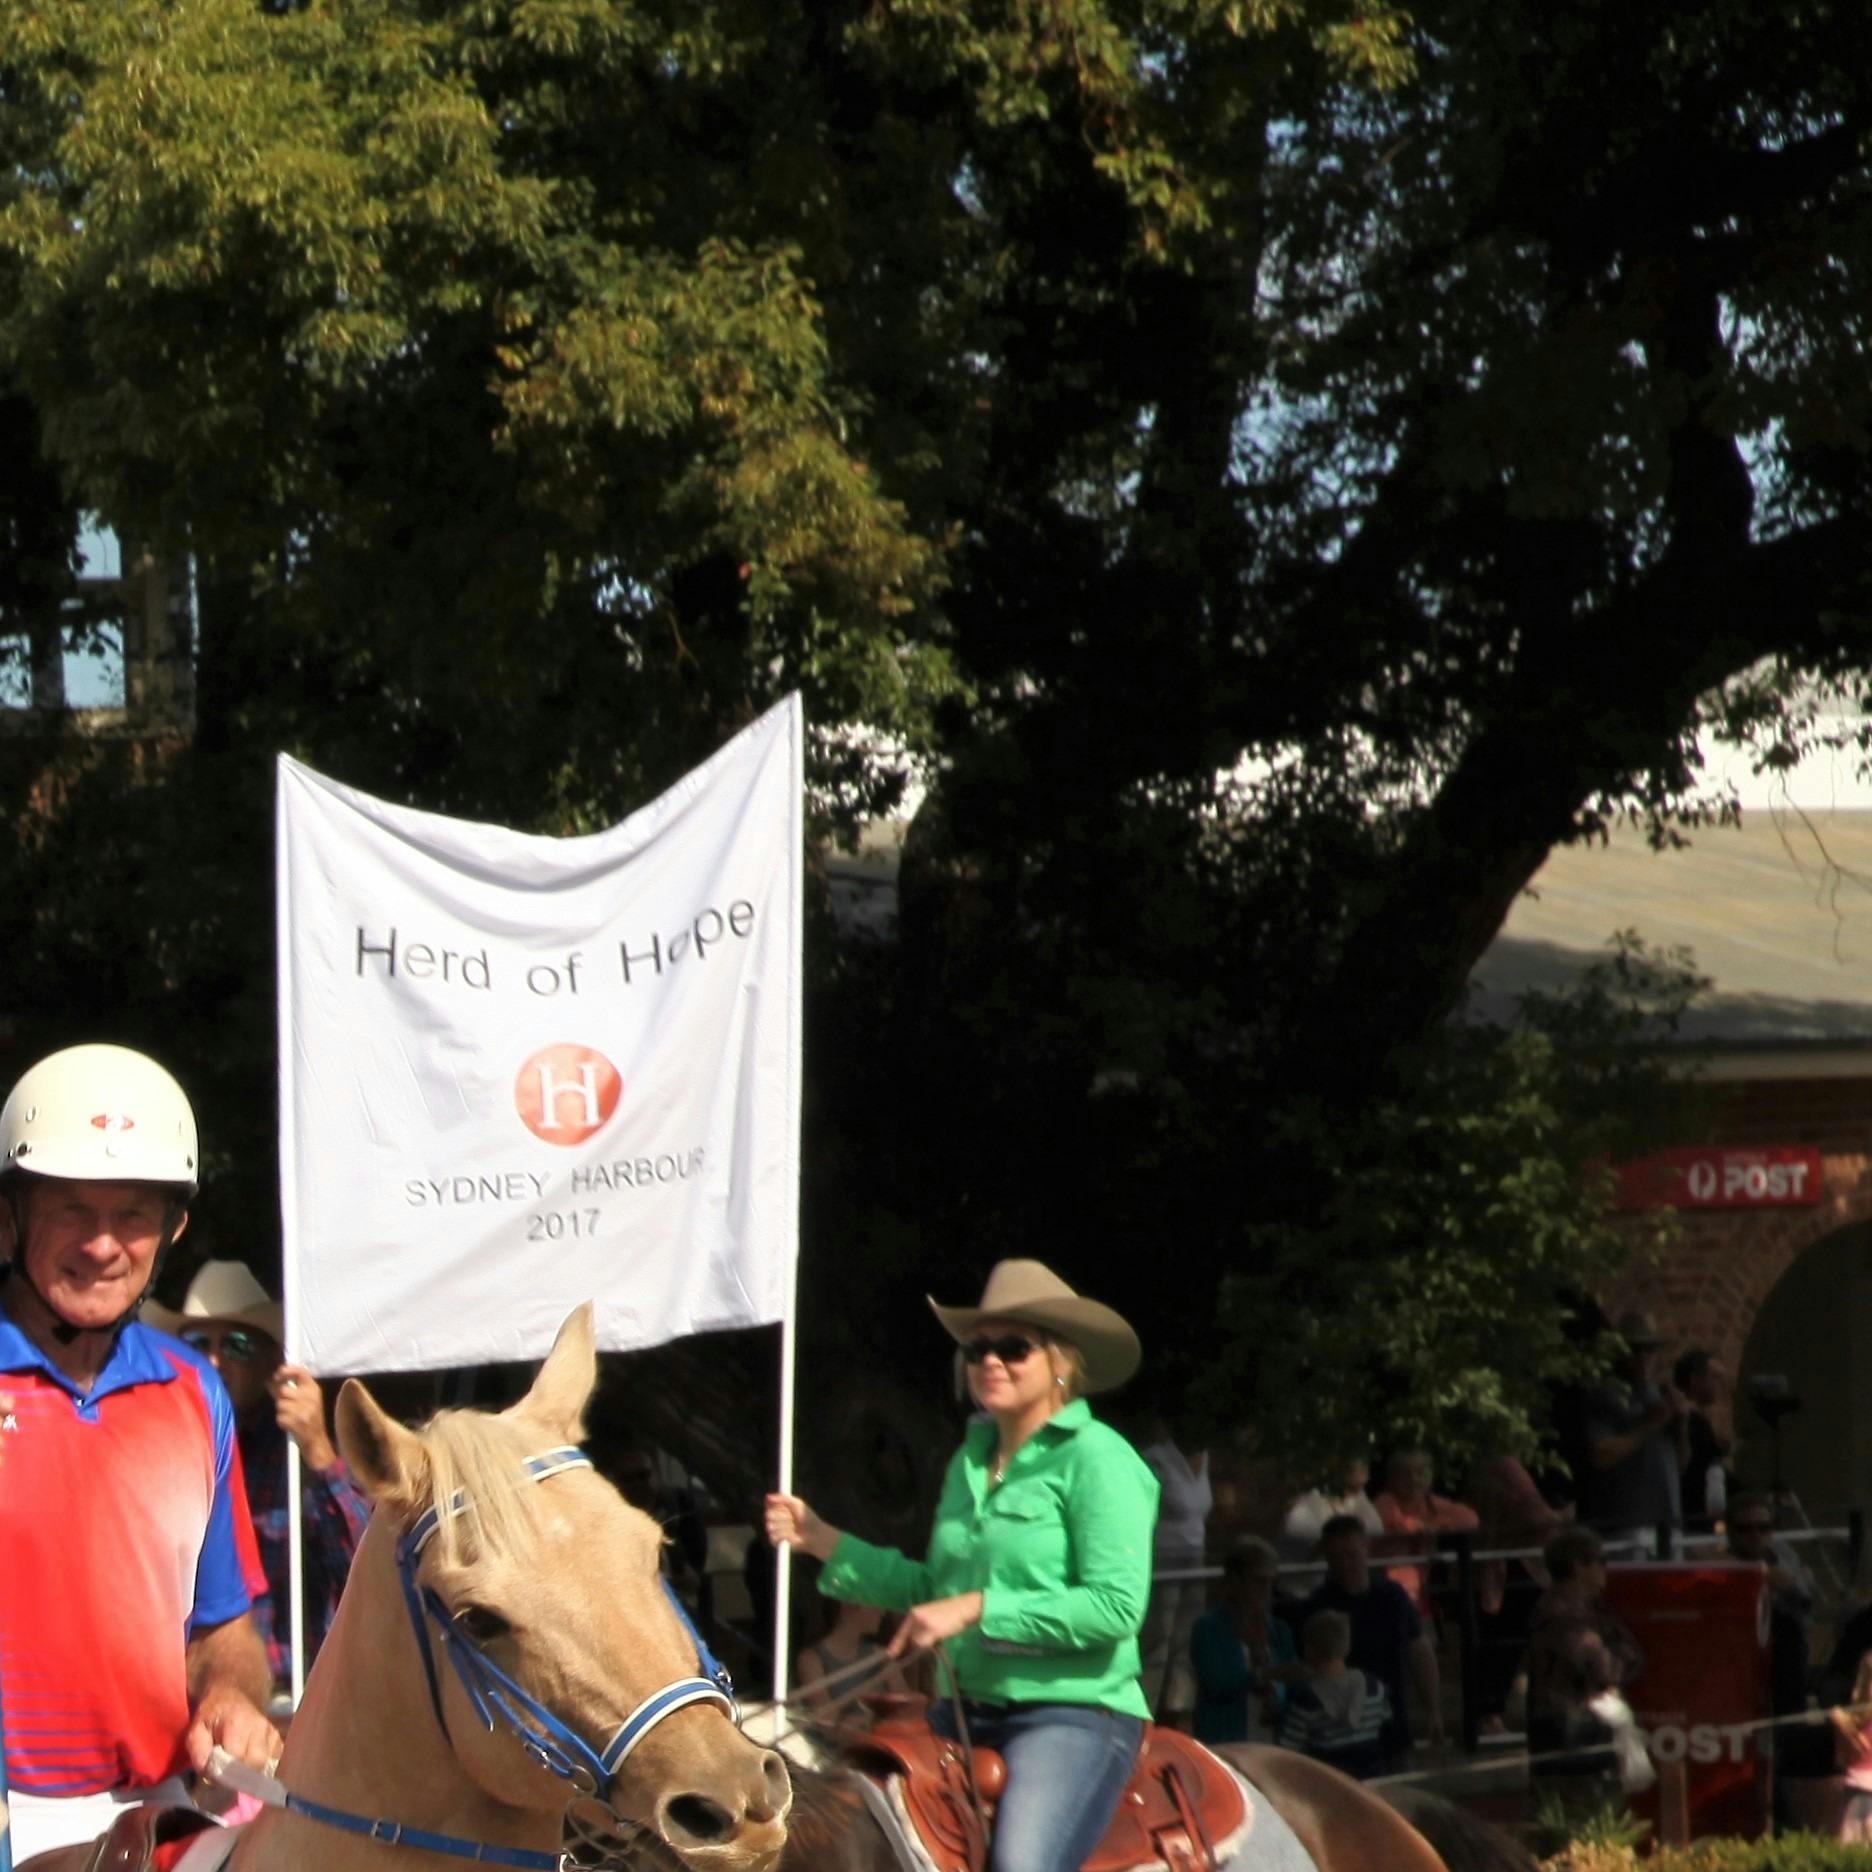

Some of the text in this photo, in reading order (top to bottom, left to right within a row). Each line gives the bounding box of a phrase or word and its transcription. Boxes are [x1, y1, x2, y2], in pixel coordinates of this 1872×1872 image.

[355, 898, 755, 996] Herd of Hope
[536, 1061, 605, 1130] H
[406, 1147, 706, 1207] SYDNEY HARBOUR
[1723, 1162, 1809, 1199] POST
[526, 1209, 600, 1242] 2017
[1641, 1724, 1751, 1763] OST
